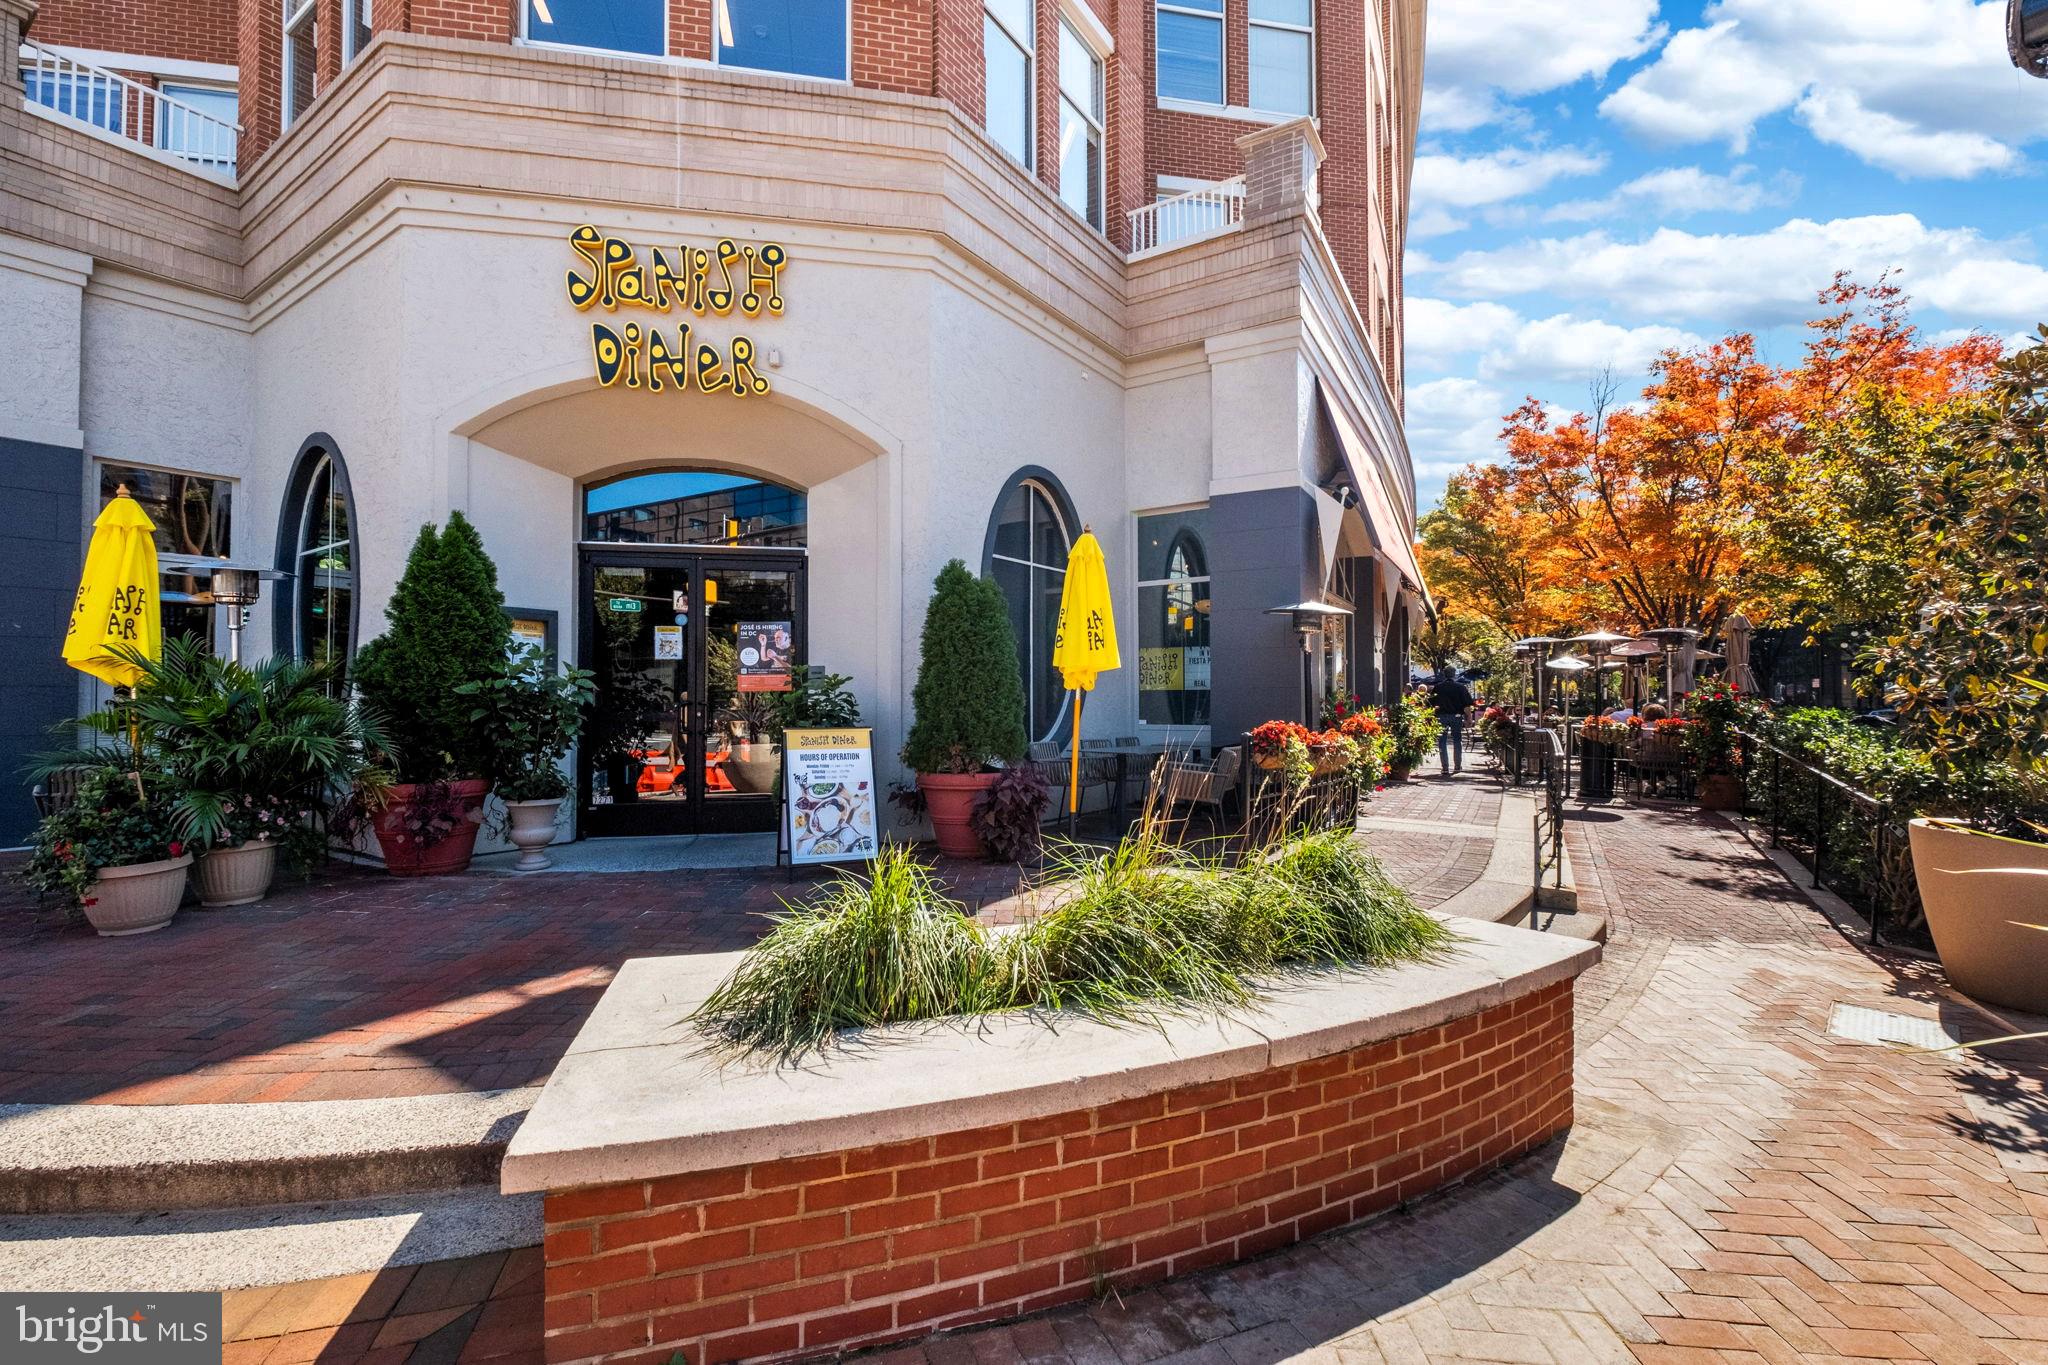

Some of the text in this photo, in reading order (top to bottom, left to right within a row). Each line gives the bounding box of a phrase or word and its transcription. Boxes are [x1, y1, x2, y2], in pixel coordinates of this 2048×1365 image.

[800, 752, 860, 761] HOURS OF OPERATION
